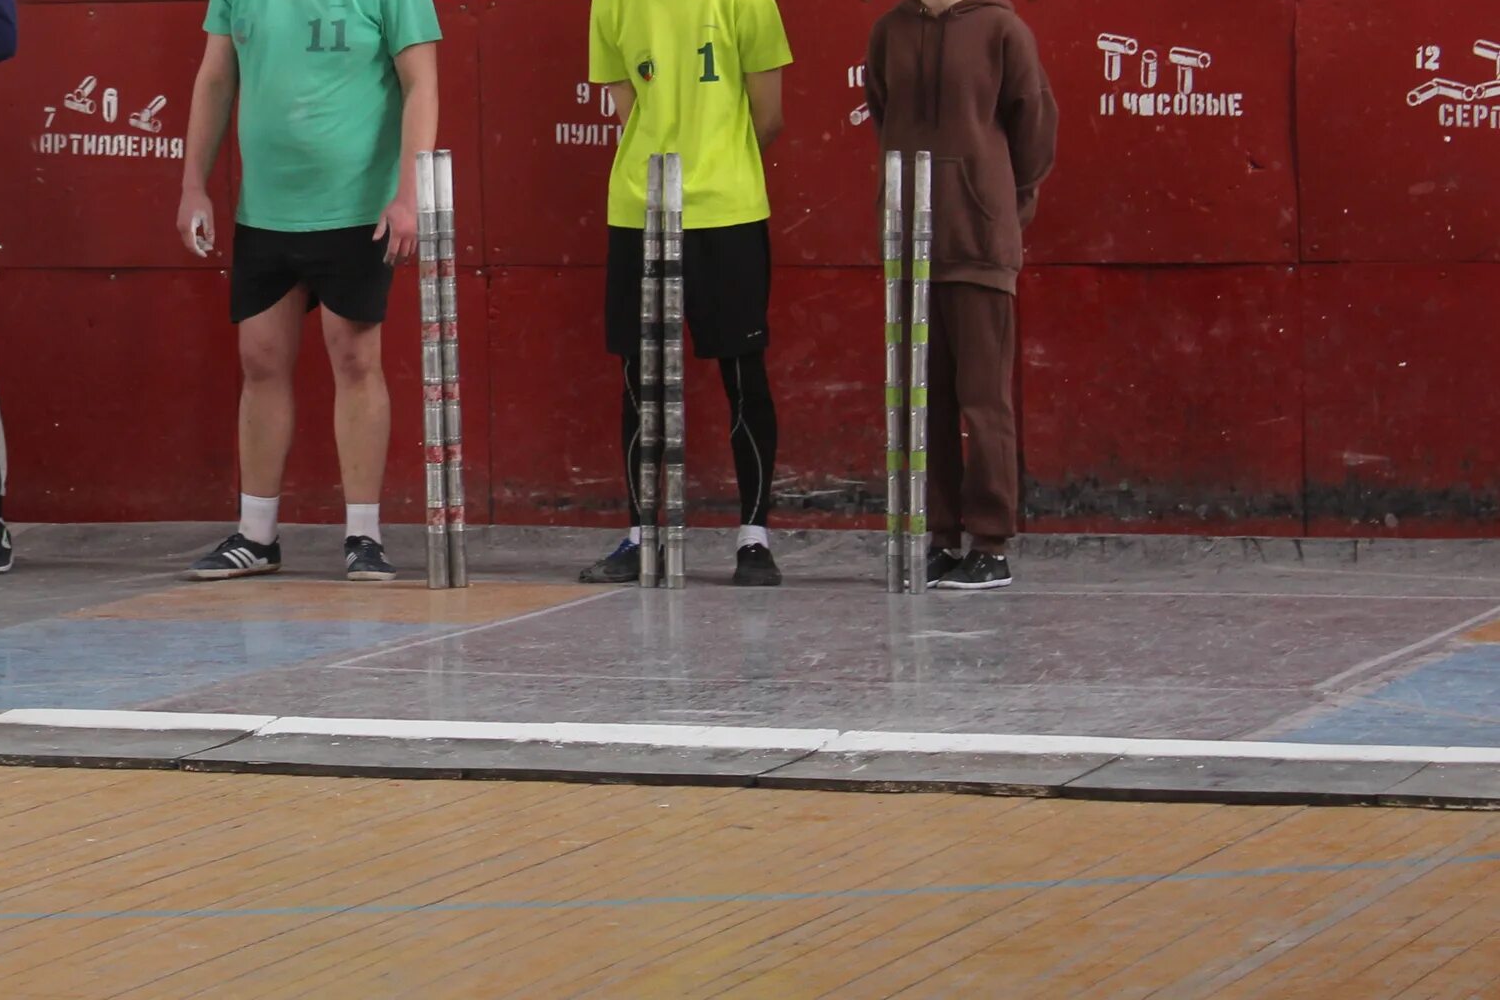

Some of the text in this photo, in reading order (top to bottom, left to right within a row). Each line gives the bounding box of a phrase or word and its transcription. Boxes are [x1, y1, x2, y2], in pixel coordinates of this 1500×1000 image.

[305, 18, 351, 52] 11
[697, 42, 720, 82] 1
[1416, 46, 1440, 71] 12
[576, 83, 590, 104] 9
[1122, 92, 1243, 116] ЧАСОВЫЕ
[44, 107, 56, 128] 7
[39, 133, 184, 159] АРТИЛЛЕРИЯ
